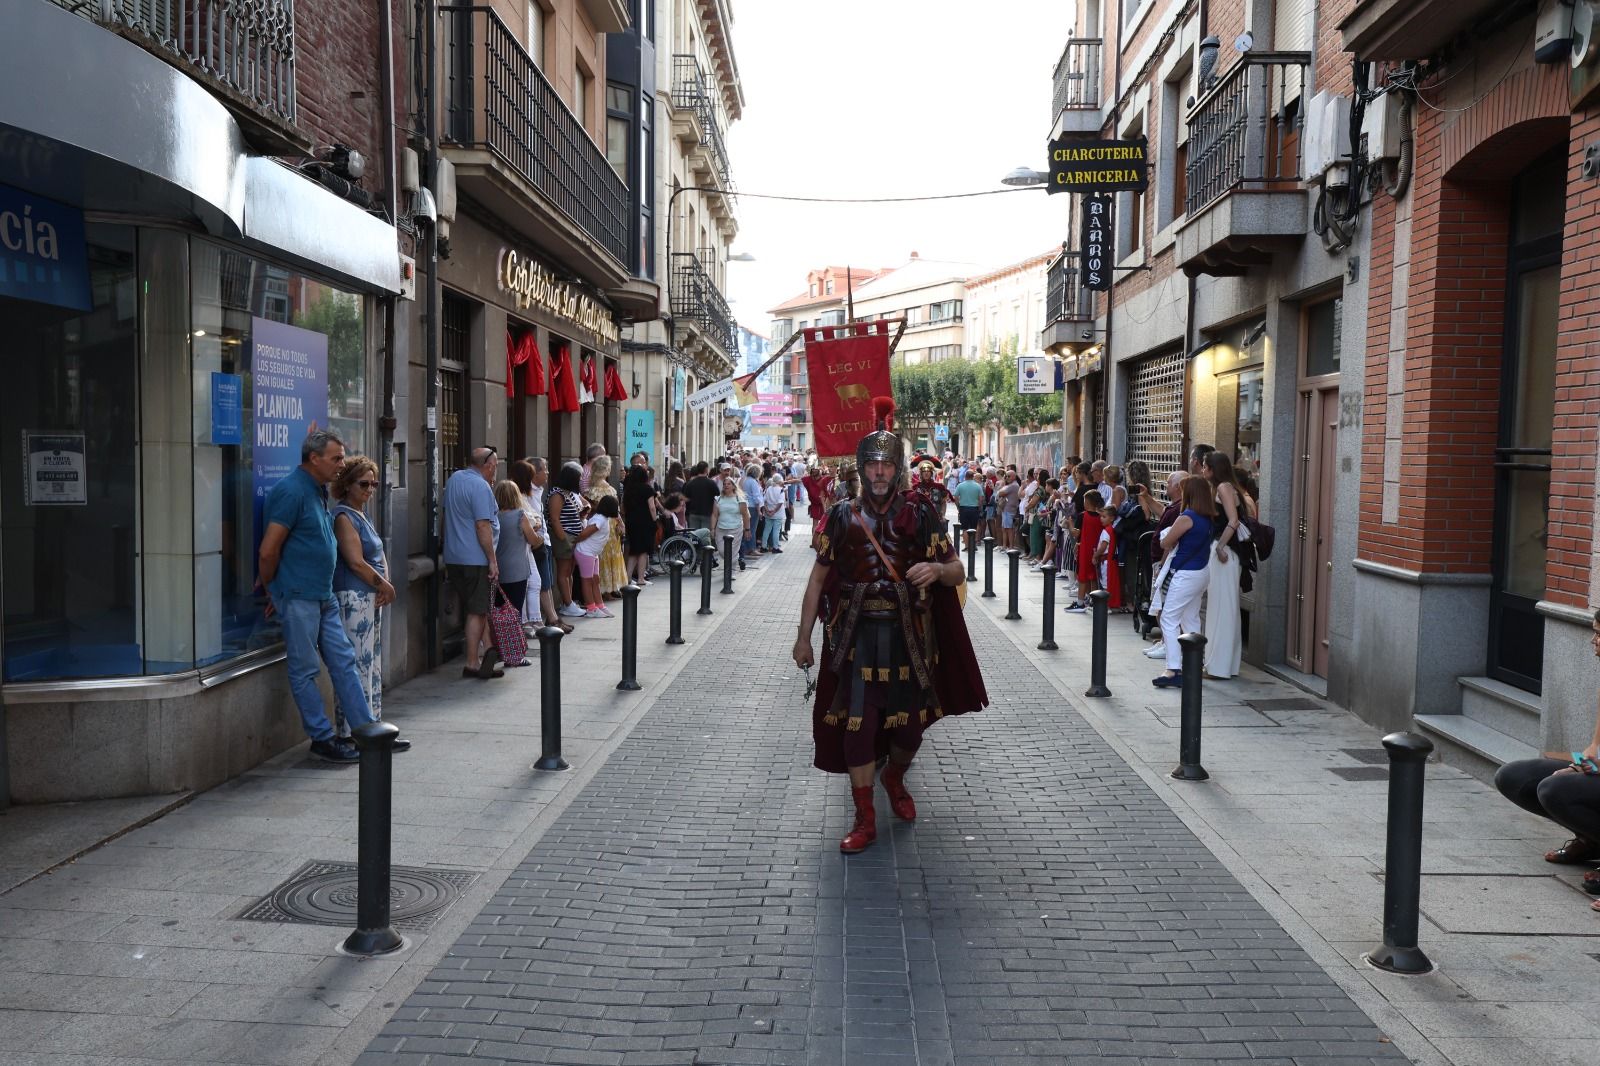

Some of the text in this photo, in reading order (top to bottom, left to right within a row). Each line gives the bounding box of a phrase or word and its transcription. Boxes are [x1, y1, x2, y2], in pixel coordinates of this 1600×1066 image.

[1053, 147, 1144, 161] CHARCUTERIA
[1056, 169, 1139, 184] CARNICERIA
[1088, 201, 1103, 285] BARROS
[257, 343, 308, 365] PORQUE NO TODOS
[257, 359, 316, 380] LOS SEGUROS DE VIDA
[828, 359, 872, 375] LEG VI
[257, 374, 295, 391] SON IGUALES
[257, 393, 303, 420] PLANVIDA
[690, 395, 710, 407] Diario
[709, 391, 717, 399] de
[257, 422, 289, 447] MUJER
[827, 420, 873, 434] VICTRI
